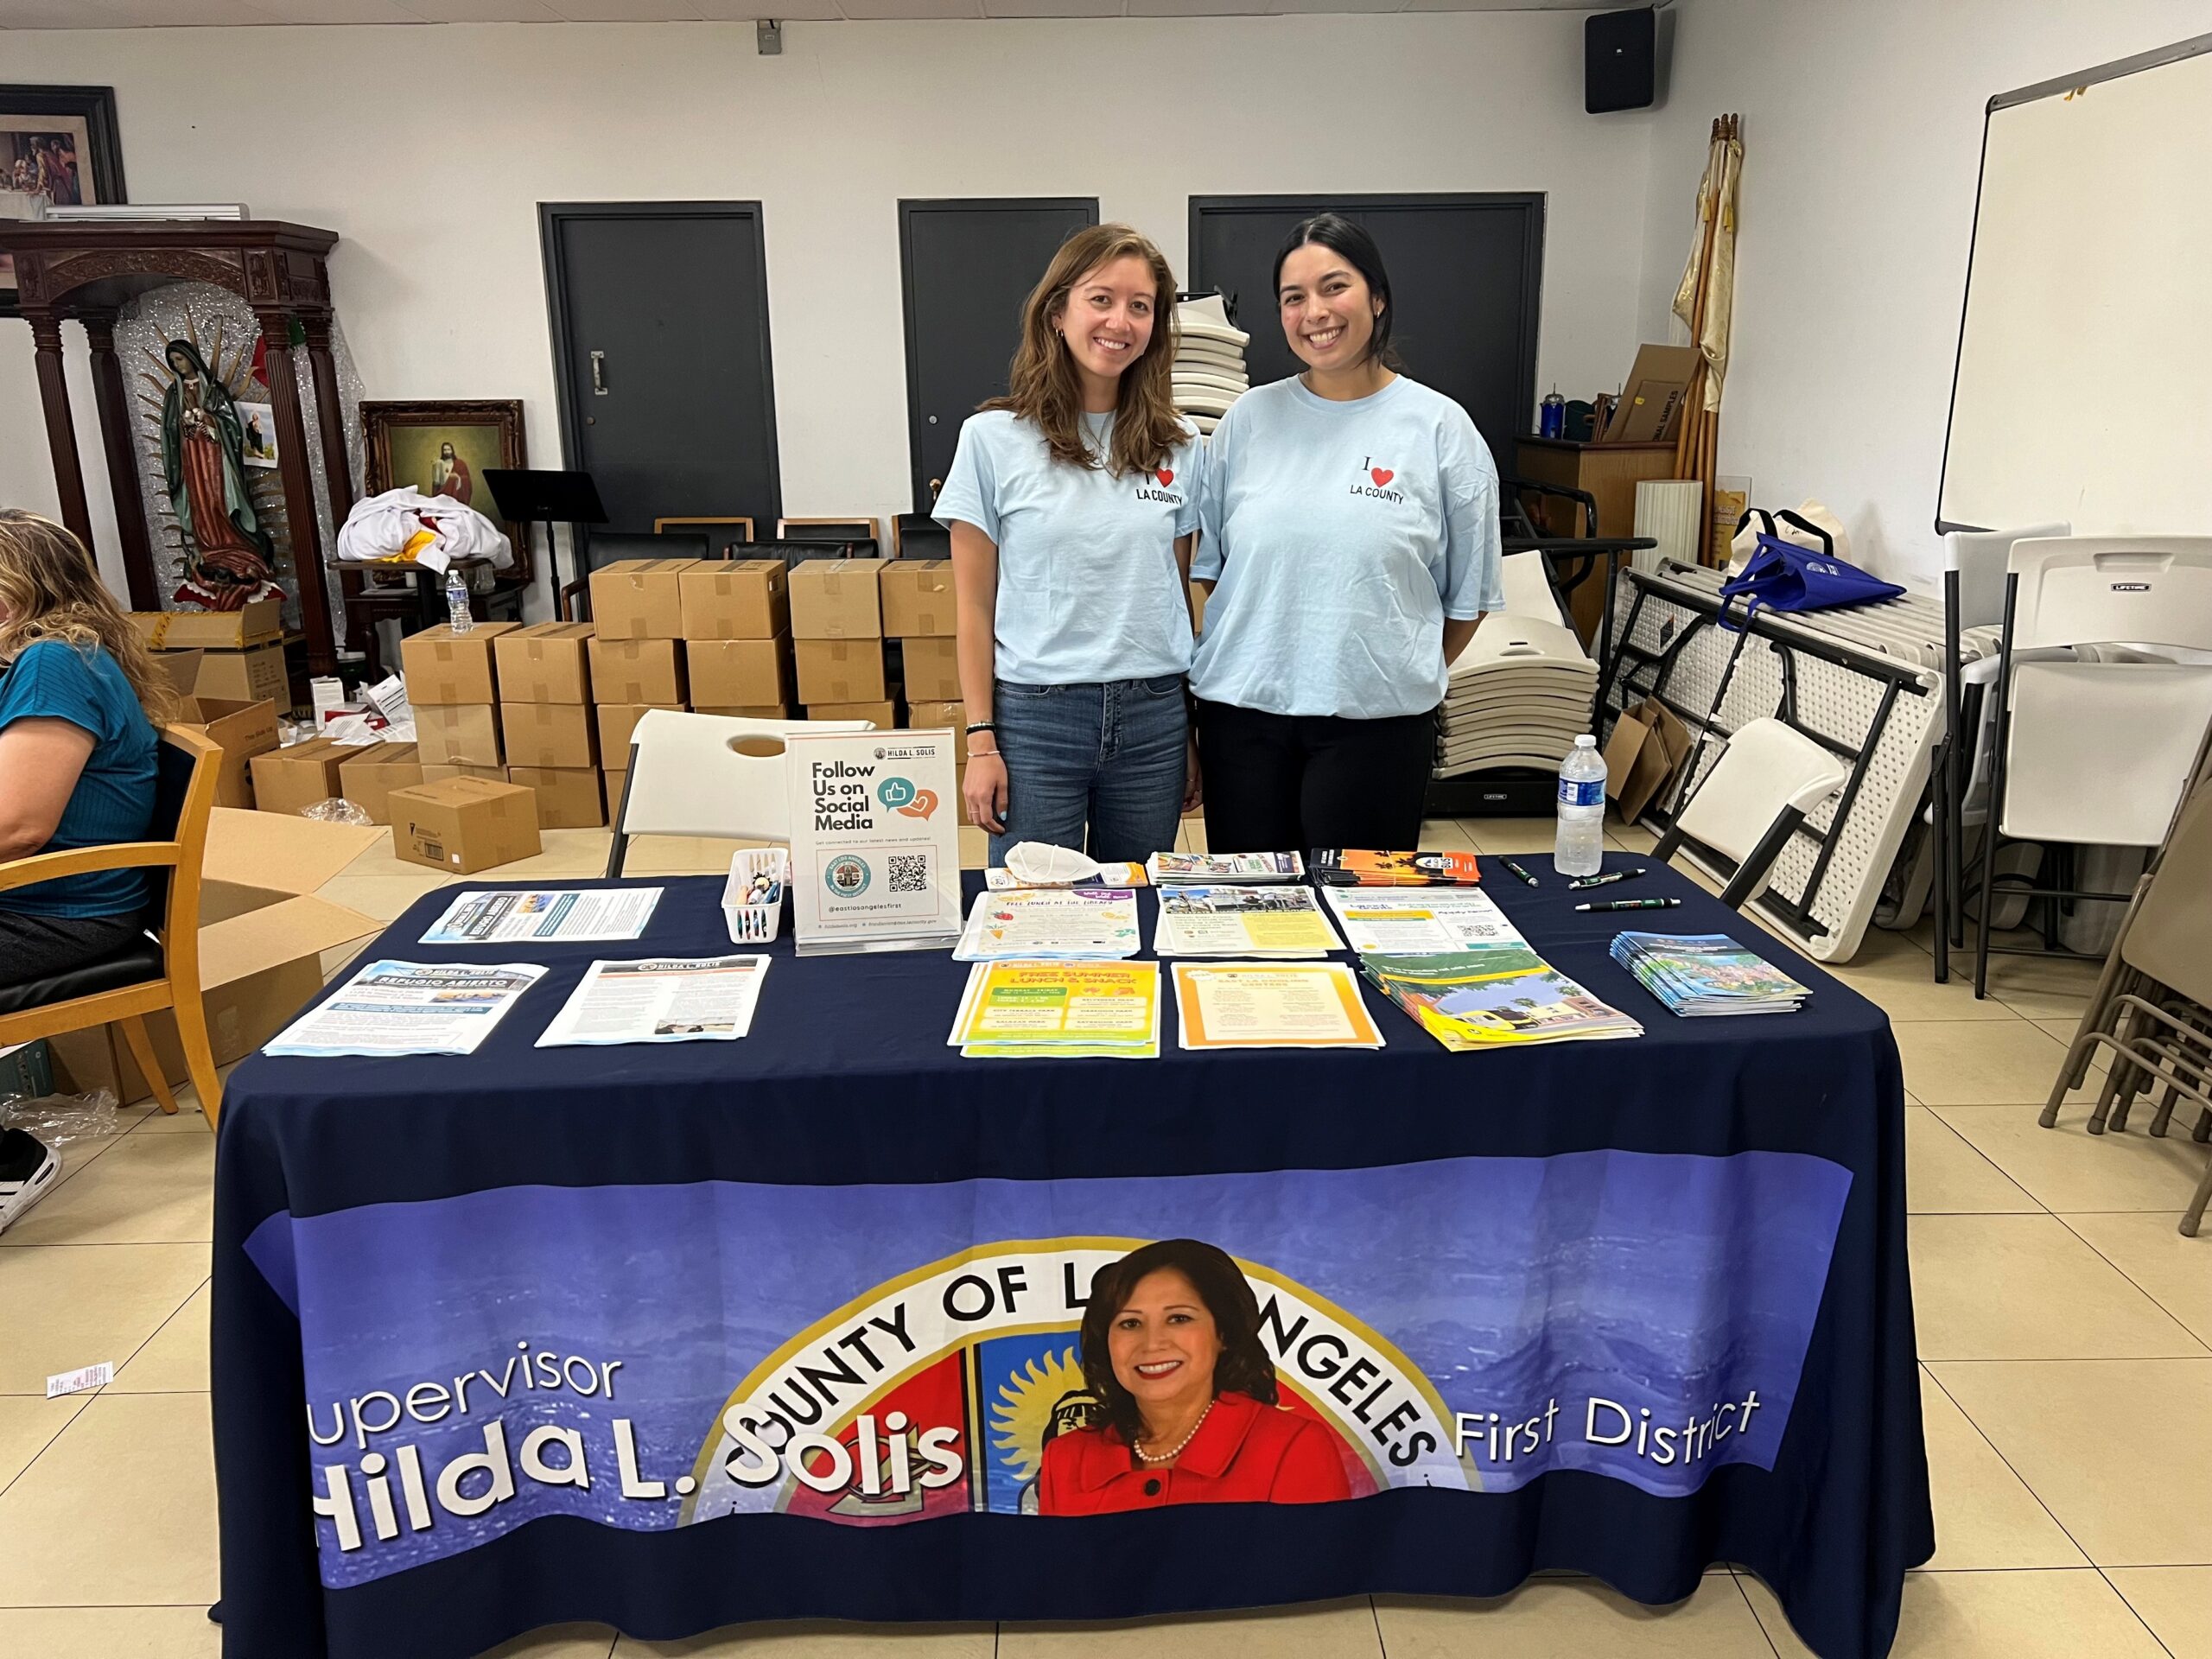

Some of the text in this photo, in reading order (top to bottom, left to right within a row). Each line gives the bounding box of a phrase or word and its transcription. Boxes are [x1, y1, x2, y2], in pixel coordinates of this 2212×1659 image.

[1363, 456, 1371, 471] I
[1136, 489, 1183, 506] LA COUNTY
[1350, 484, 1404, 505] LA COUNTY
[812, 760, 875, 778] Follow
[813, 780, 864, 796] Us on
[815, 796, 869, 813] Social
[815, 815, 873, 831] Media
[1440, 857, 1451, 868] BUS
[829, 903, 901, 912] @eastlosangelesfirst
[378, 976, 443, 986] REFUGIO
[943, 1265, 1028, 1322] OF
[1257, 1294, 1437, 1467] NGELES
[307, 1341, 622, 1451] upervisor
[1455, 1390, 1760, 1465] First District
[612, 1419, 696, 1499] L.
[723, 1402, 963, 1494] Solis
